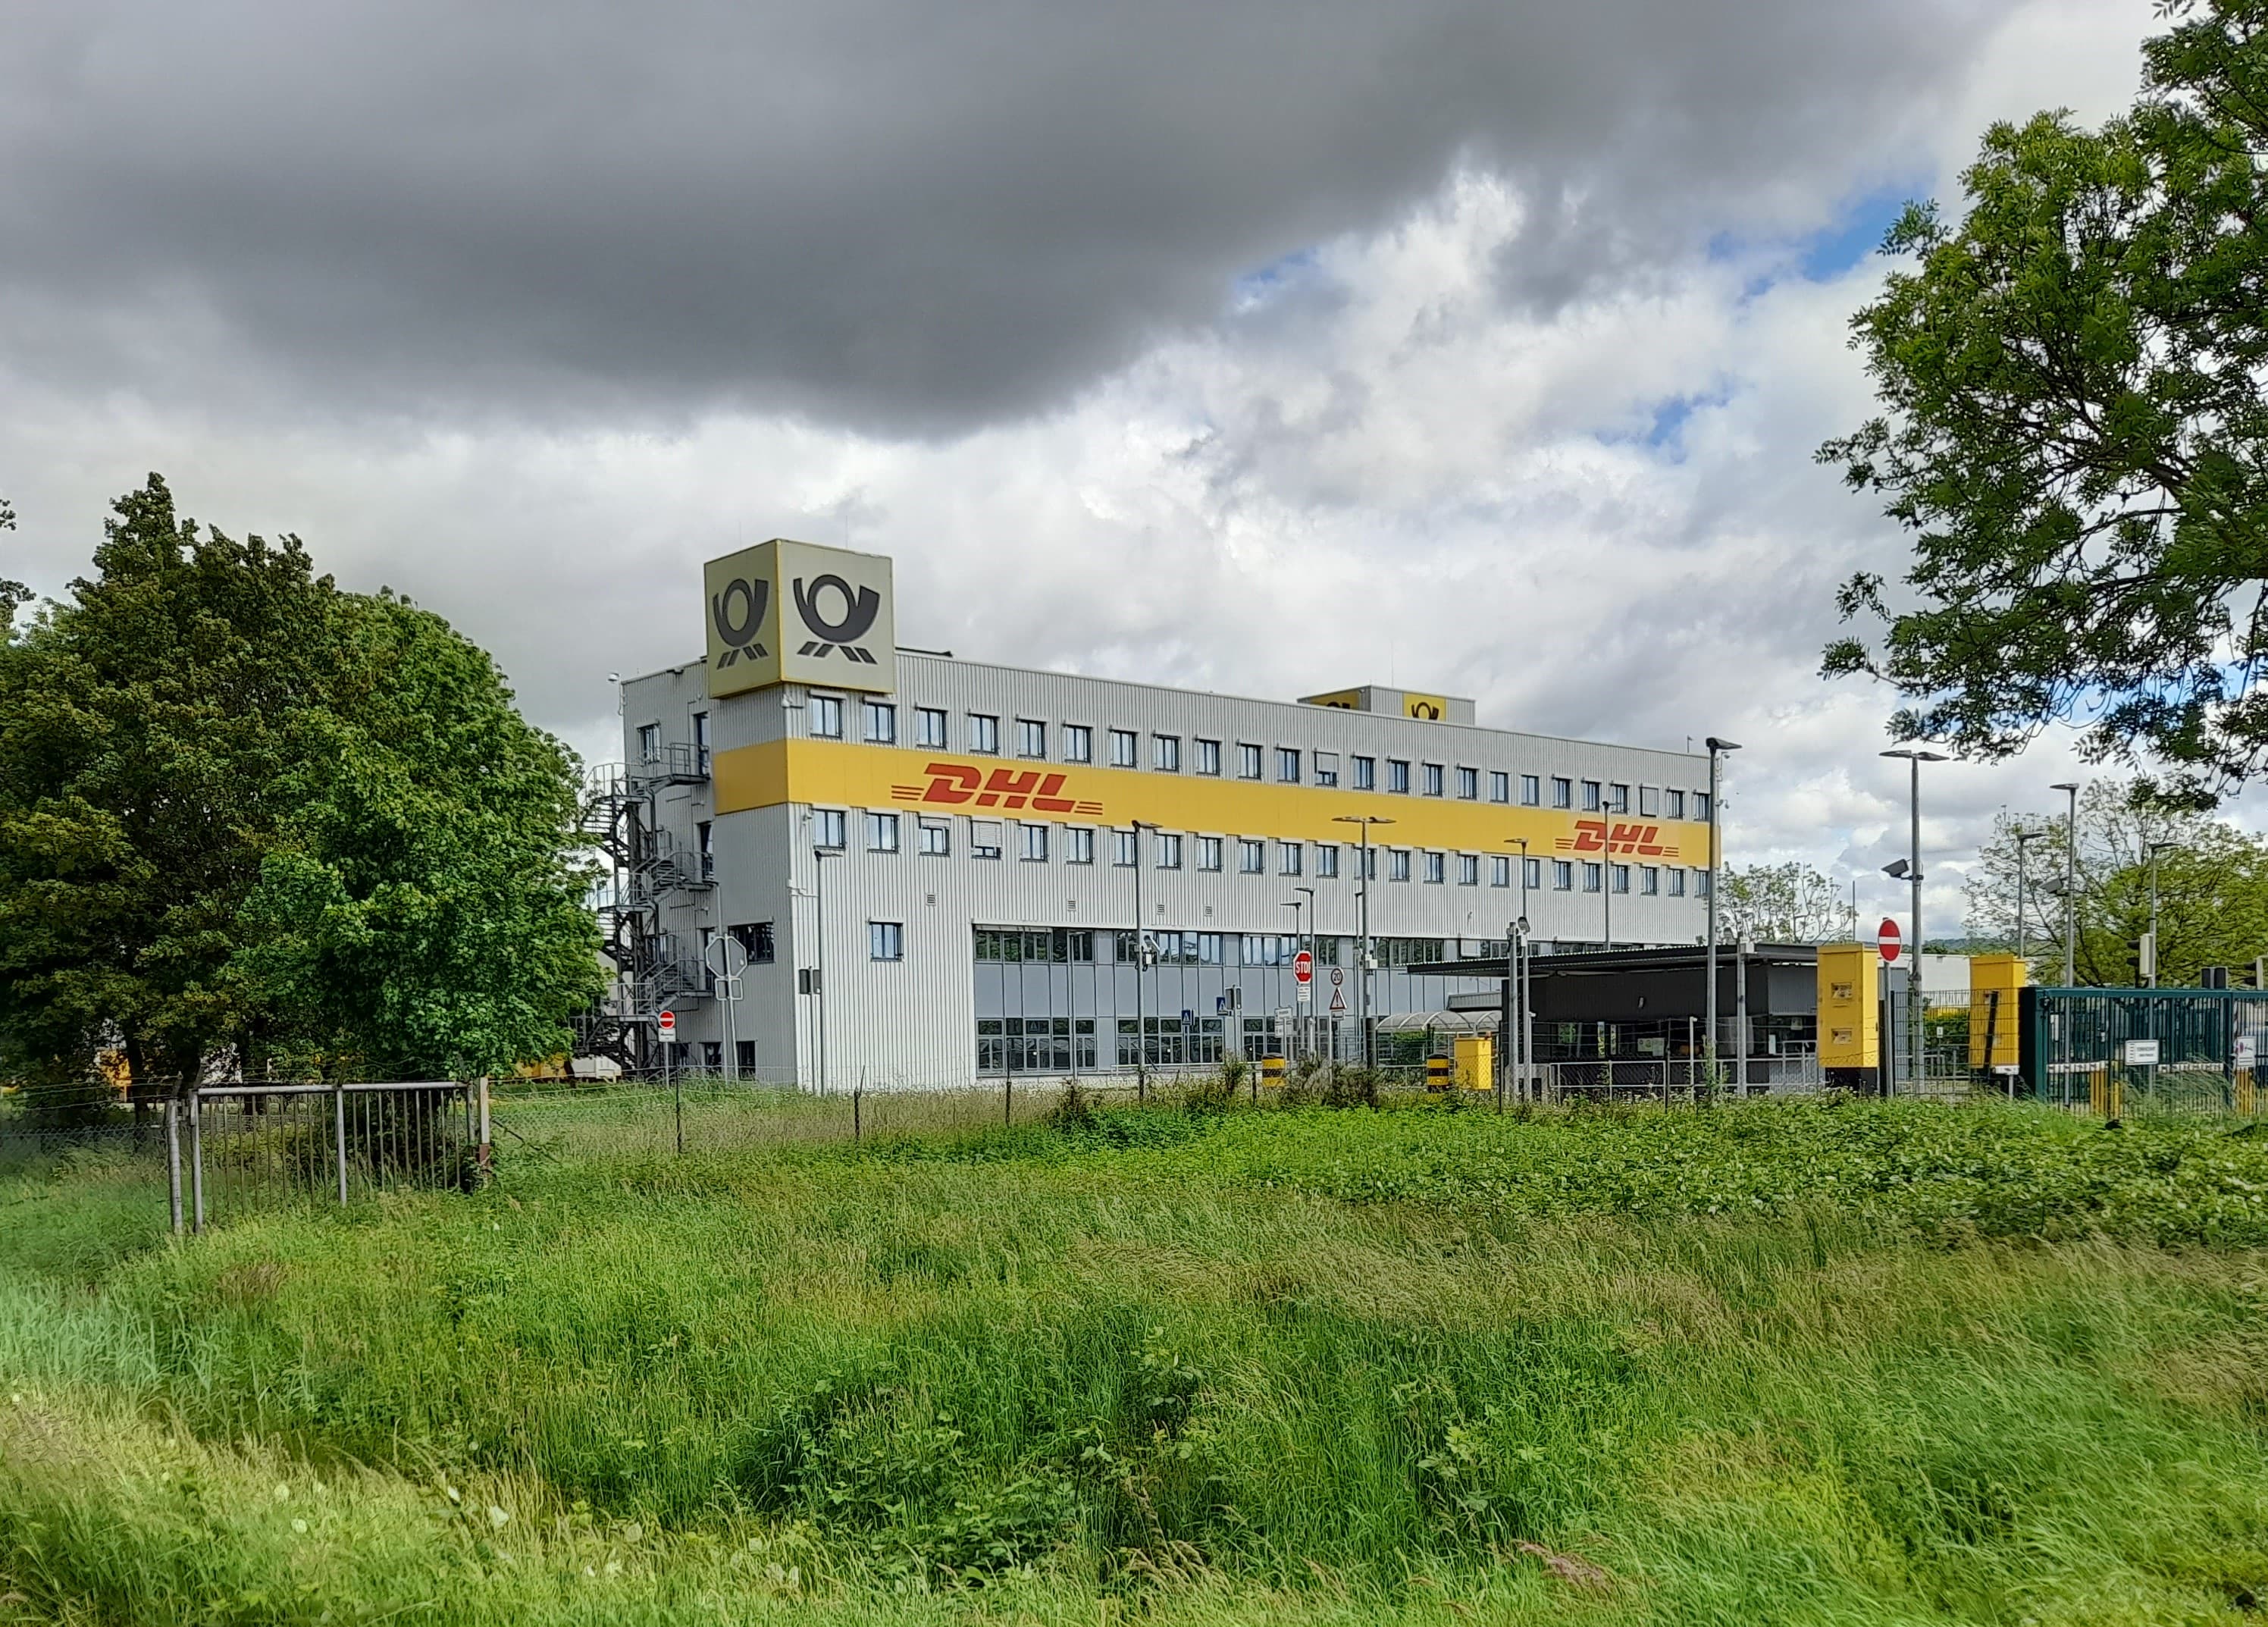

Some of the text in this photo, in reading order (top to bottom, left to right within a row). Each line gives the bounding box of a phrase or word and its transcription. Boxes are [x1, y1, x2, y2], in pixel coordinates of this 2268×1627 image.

[923, 763, 1075, 813] DHL
[1574, 820, 1663, 855] DHL
[1333, 972, 1341, 982] 20
